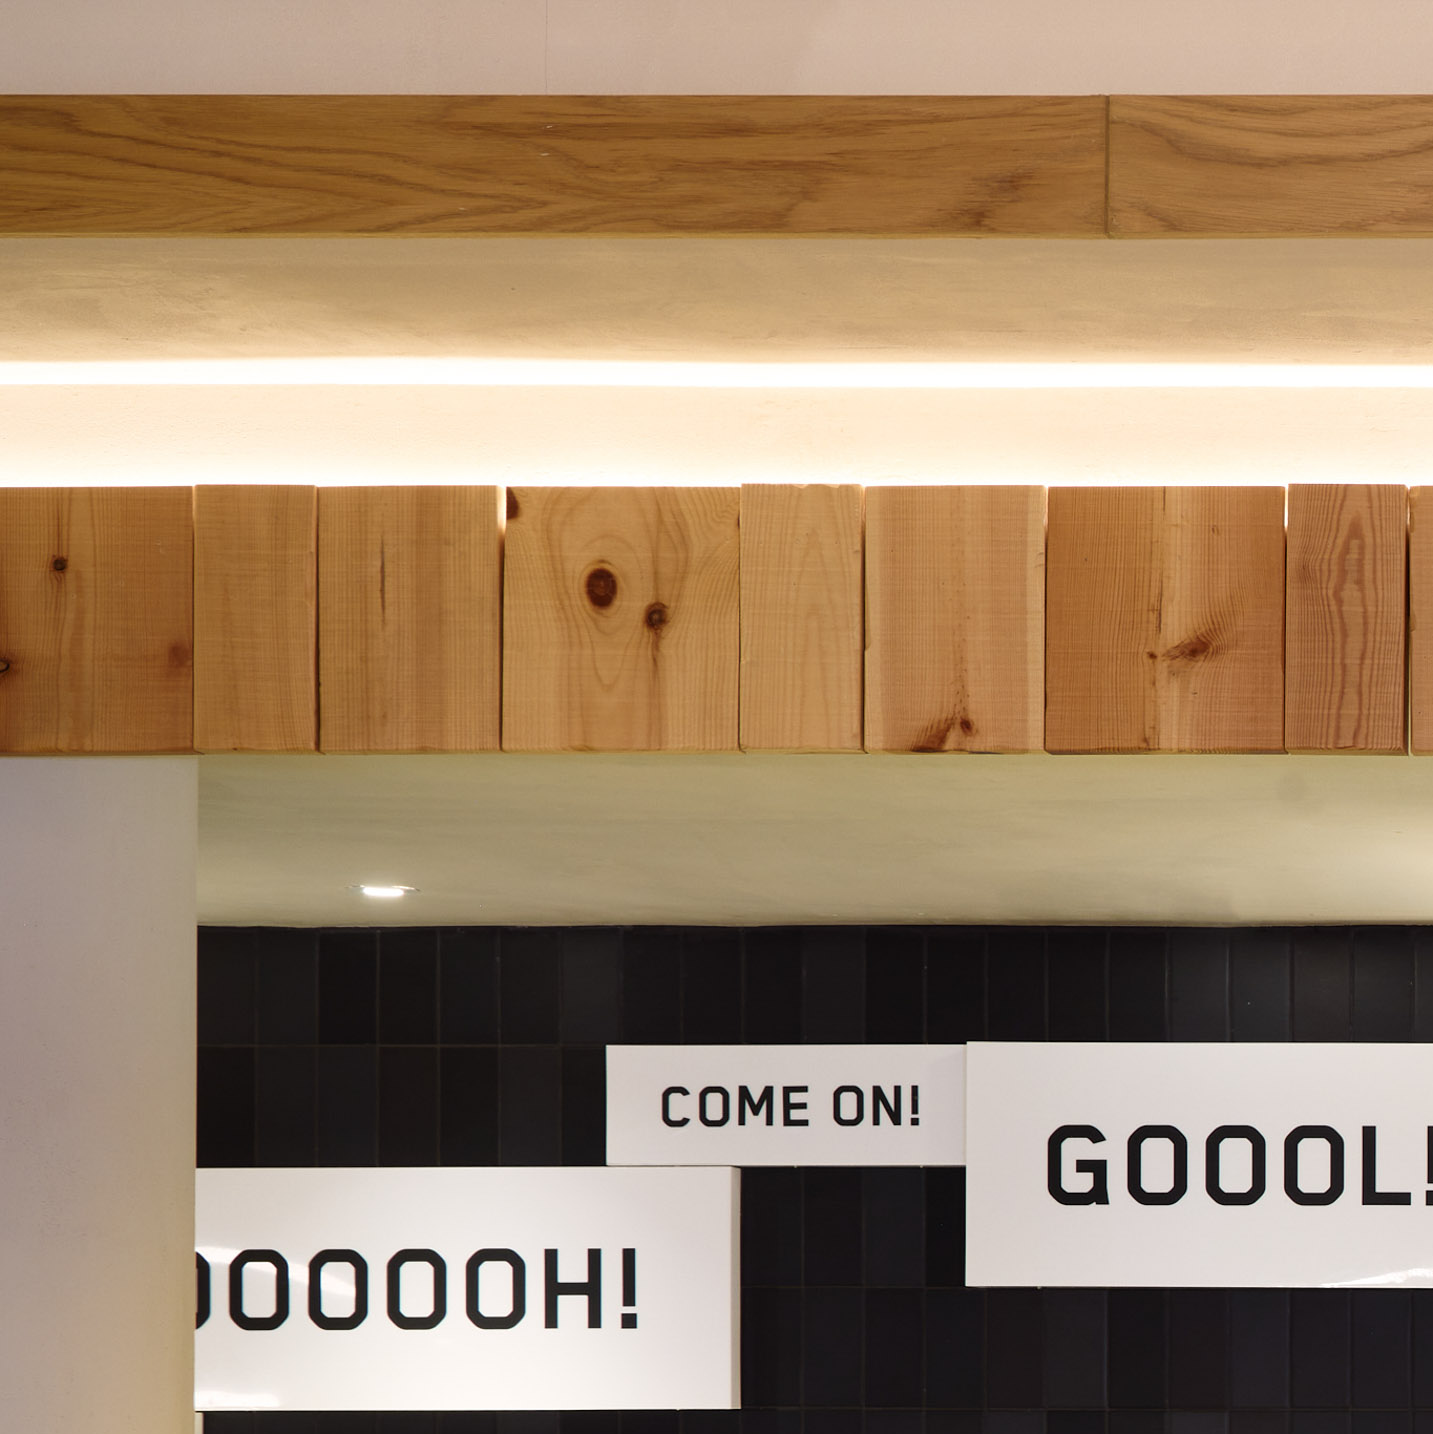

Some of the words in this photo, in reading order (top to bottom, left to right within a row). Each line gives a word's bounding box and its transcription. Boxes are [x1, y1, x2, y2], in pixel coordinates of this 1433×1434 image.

[661, 1085, 809, 1128] COME
[832, 1085, 920, 1128] ON!
[195, 1247, 638, 1331] OOOOH!
